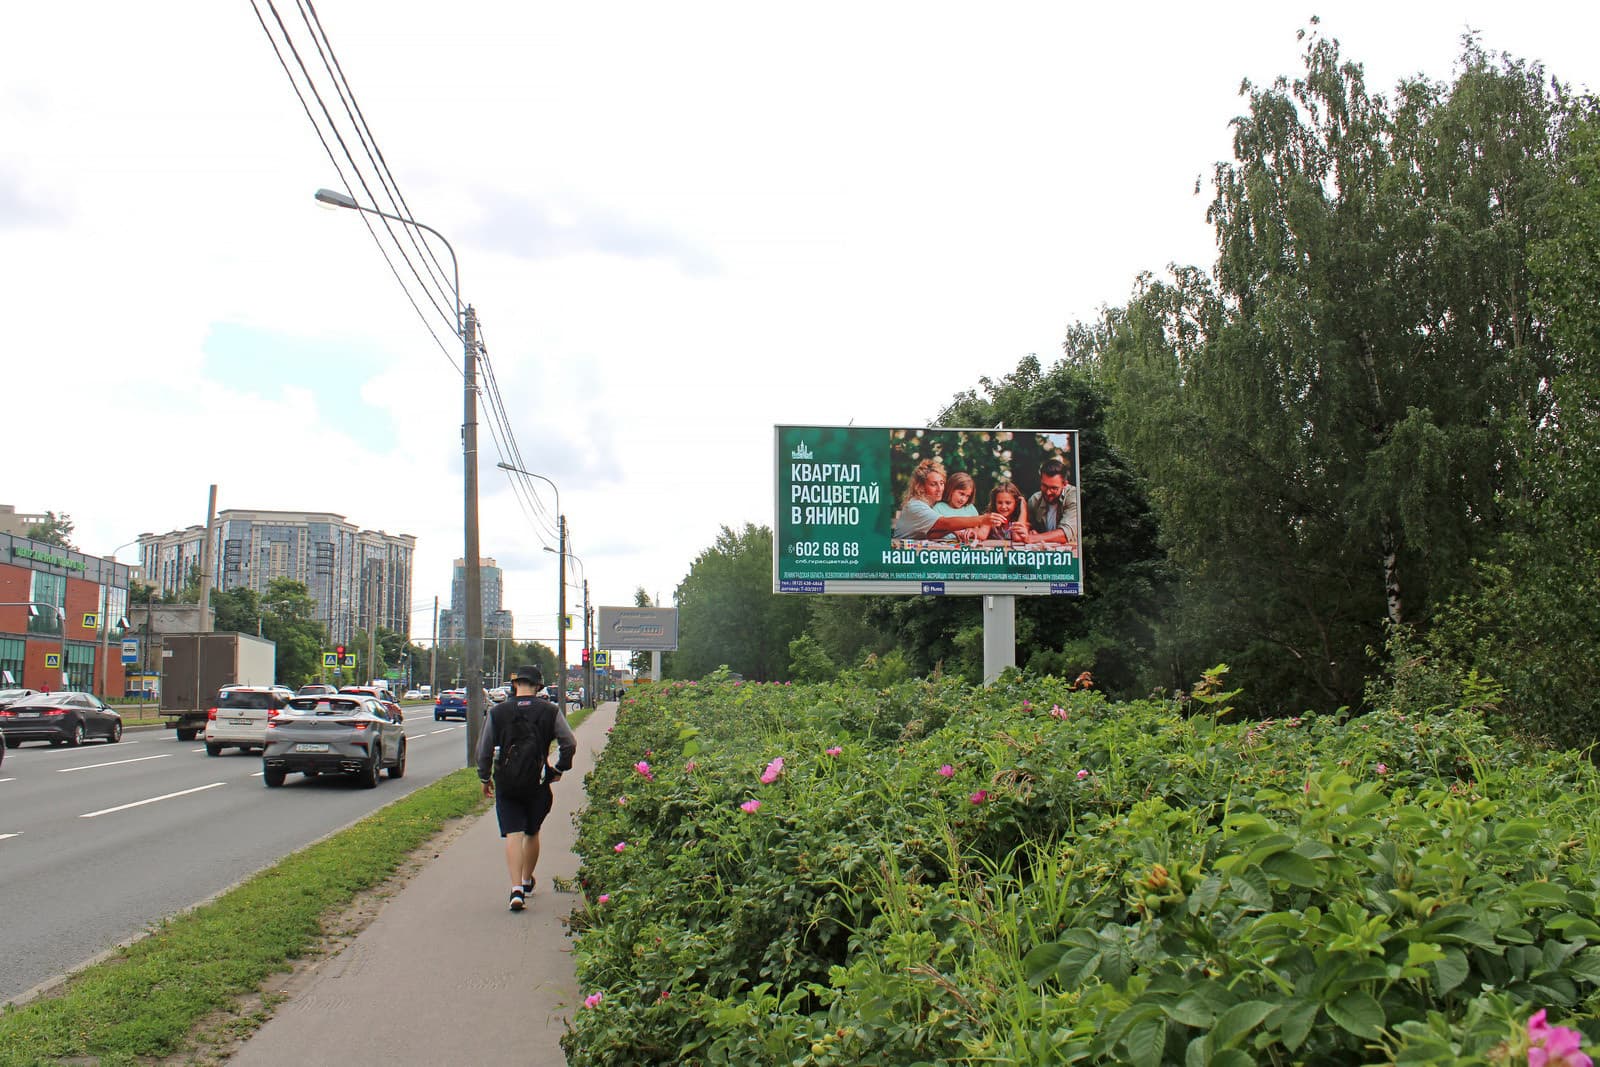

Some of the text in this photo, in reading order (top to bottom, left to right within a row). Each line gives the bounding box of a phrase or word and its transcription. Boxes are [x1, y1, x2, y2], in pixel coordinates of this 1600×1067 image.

[791, 463, 861, 482] КВАРТАЛ
[791, 481, 880, 505] РАСЦВЕТАЙ
[791, 506, 859, 525] В ЯНИНО
[795, 541, 820, 557] 602
[823, 541, 840, 557] 68
[843, 541, 859, 557] 68
[882, 548, 1072, 569] наш семейный квартал
